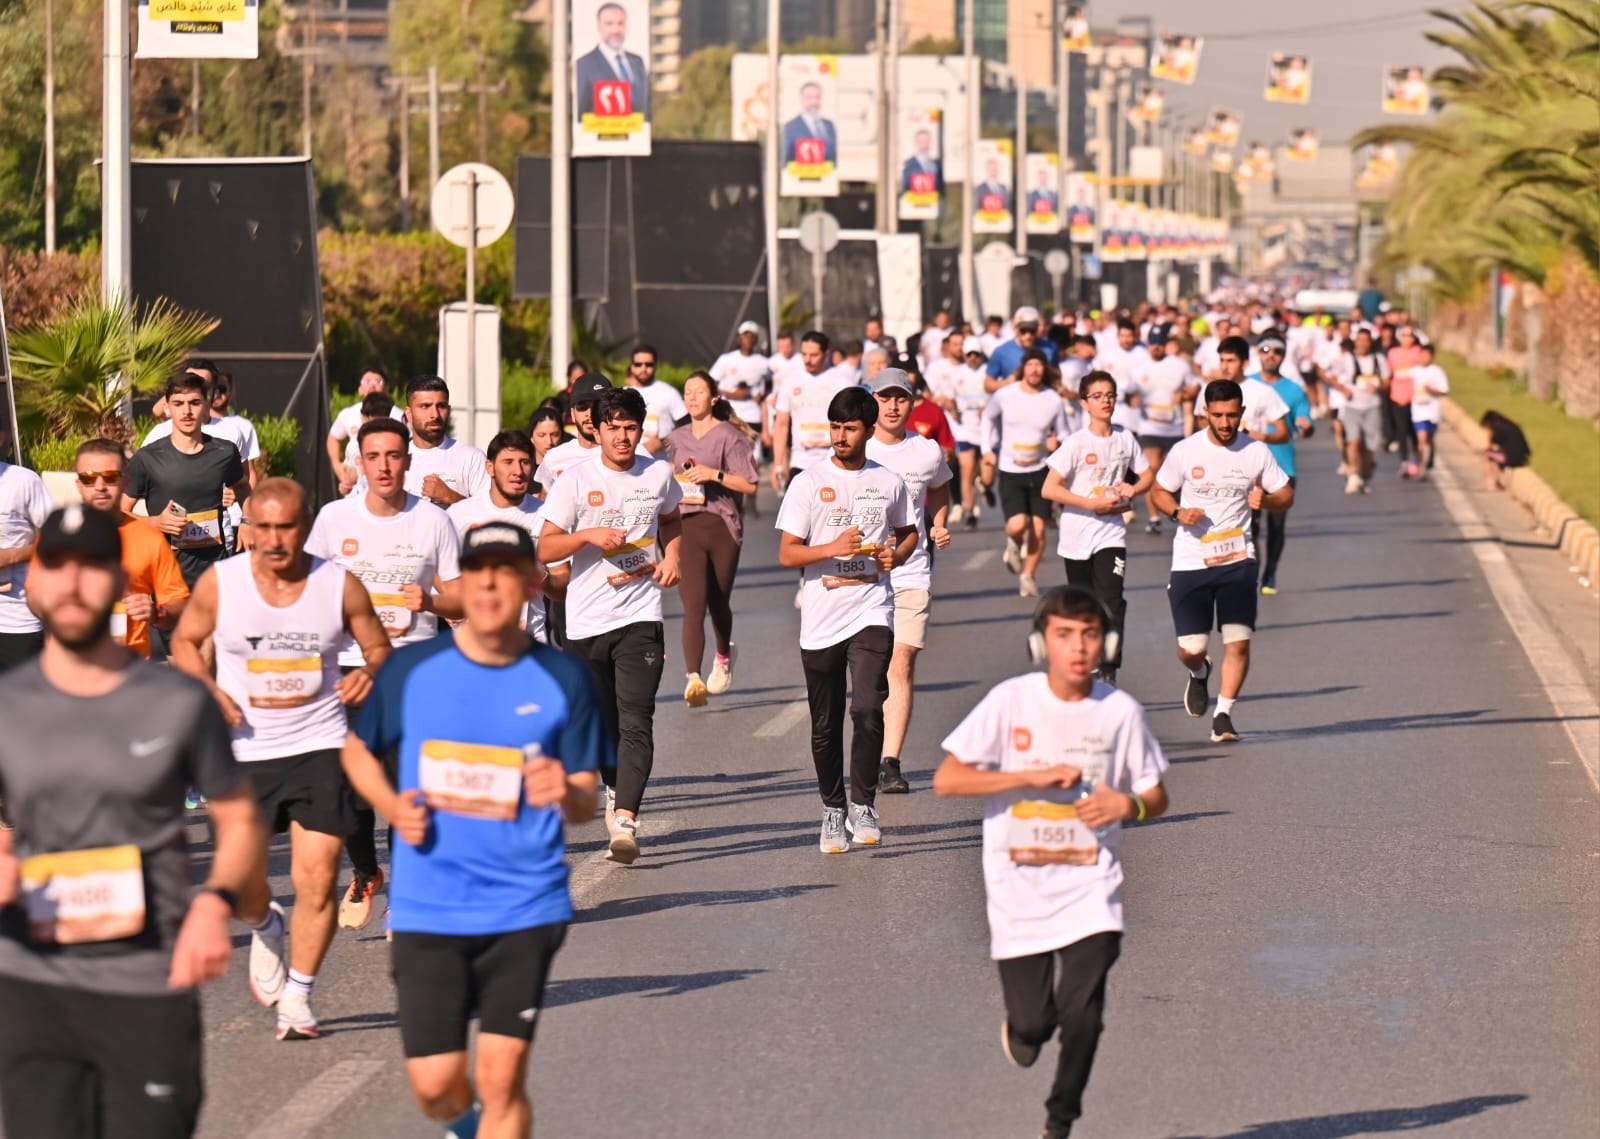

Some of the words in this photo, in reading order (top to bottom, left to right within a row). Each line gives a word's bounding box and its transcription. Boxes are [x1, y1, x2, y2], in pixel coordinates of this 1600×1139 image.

[859, 506, 882, 515] RUN
[598, 514, 655, 528] ERBIL
[827, 514, 882, 527] ERBIL
[1212, 541, 1236, 553] 1171
[617, 552, 646, 571] 1585
[835, 560, 866, 573] 1583
[379, 610, 397, 623] 65
[266, 632, 321, 641] UNDER
[269, 641, 321, 653] ARMOUR
[265, 678, 305, 692] 1360
[1032, 827, 1077, 843] 1551
